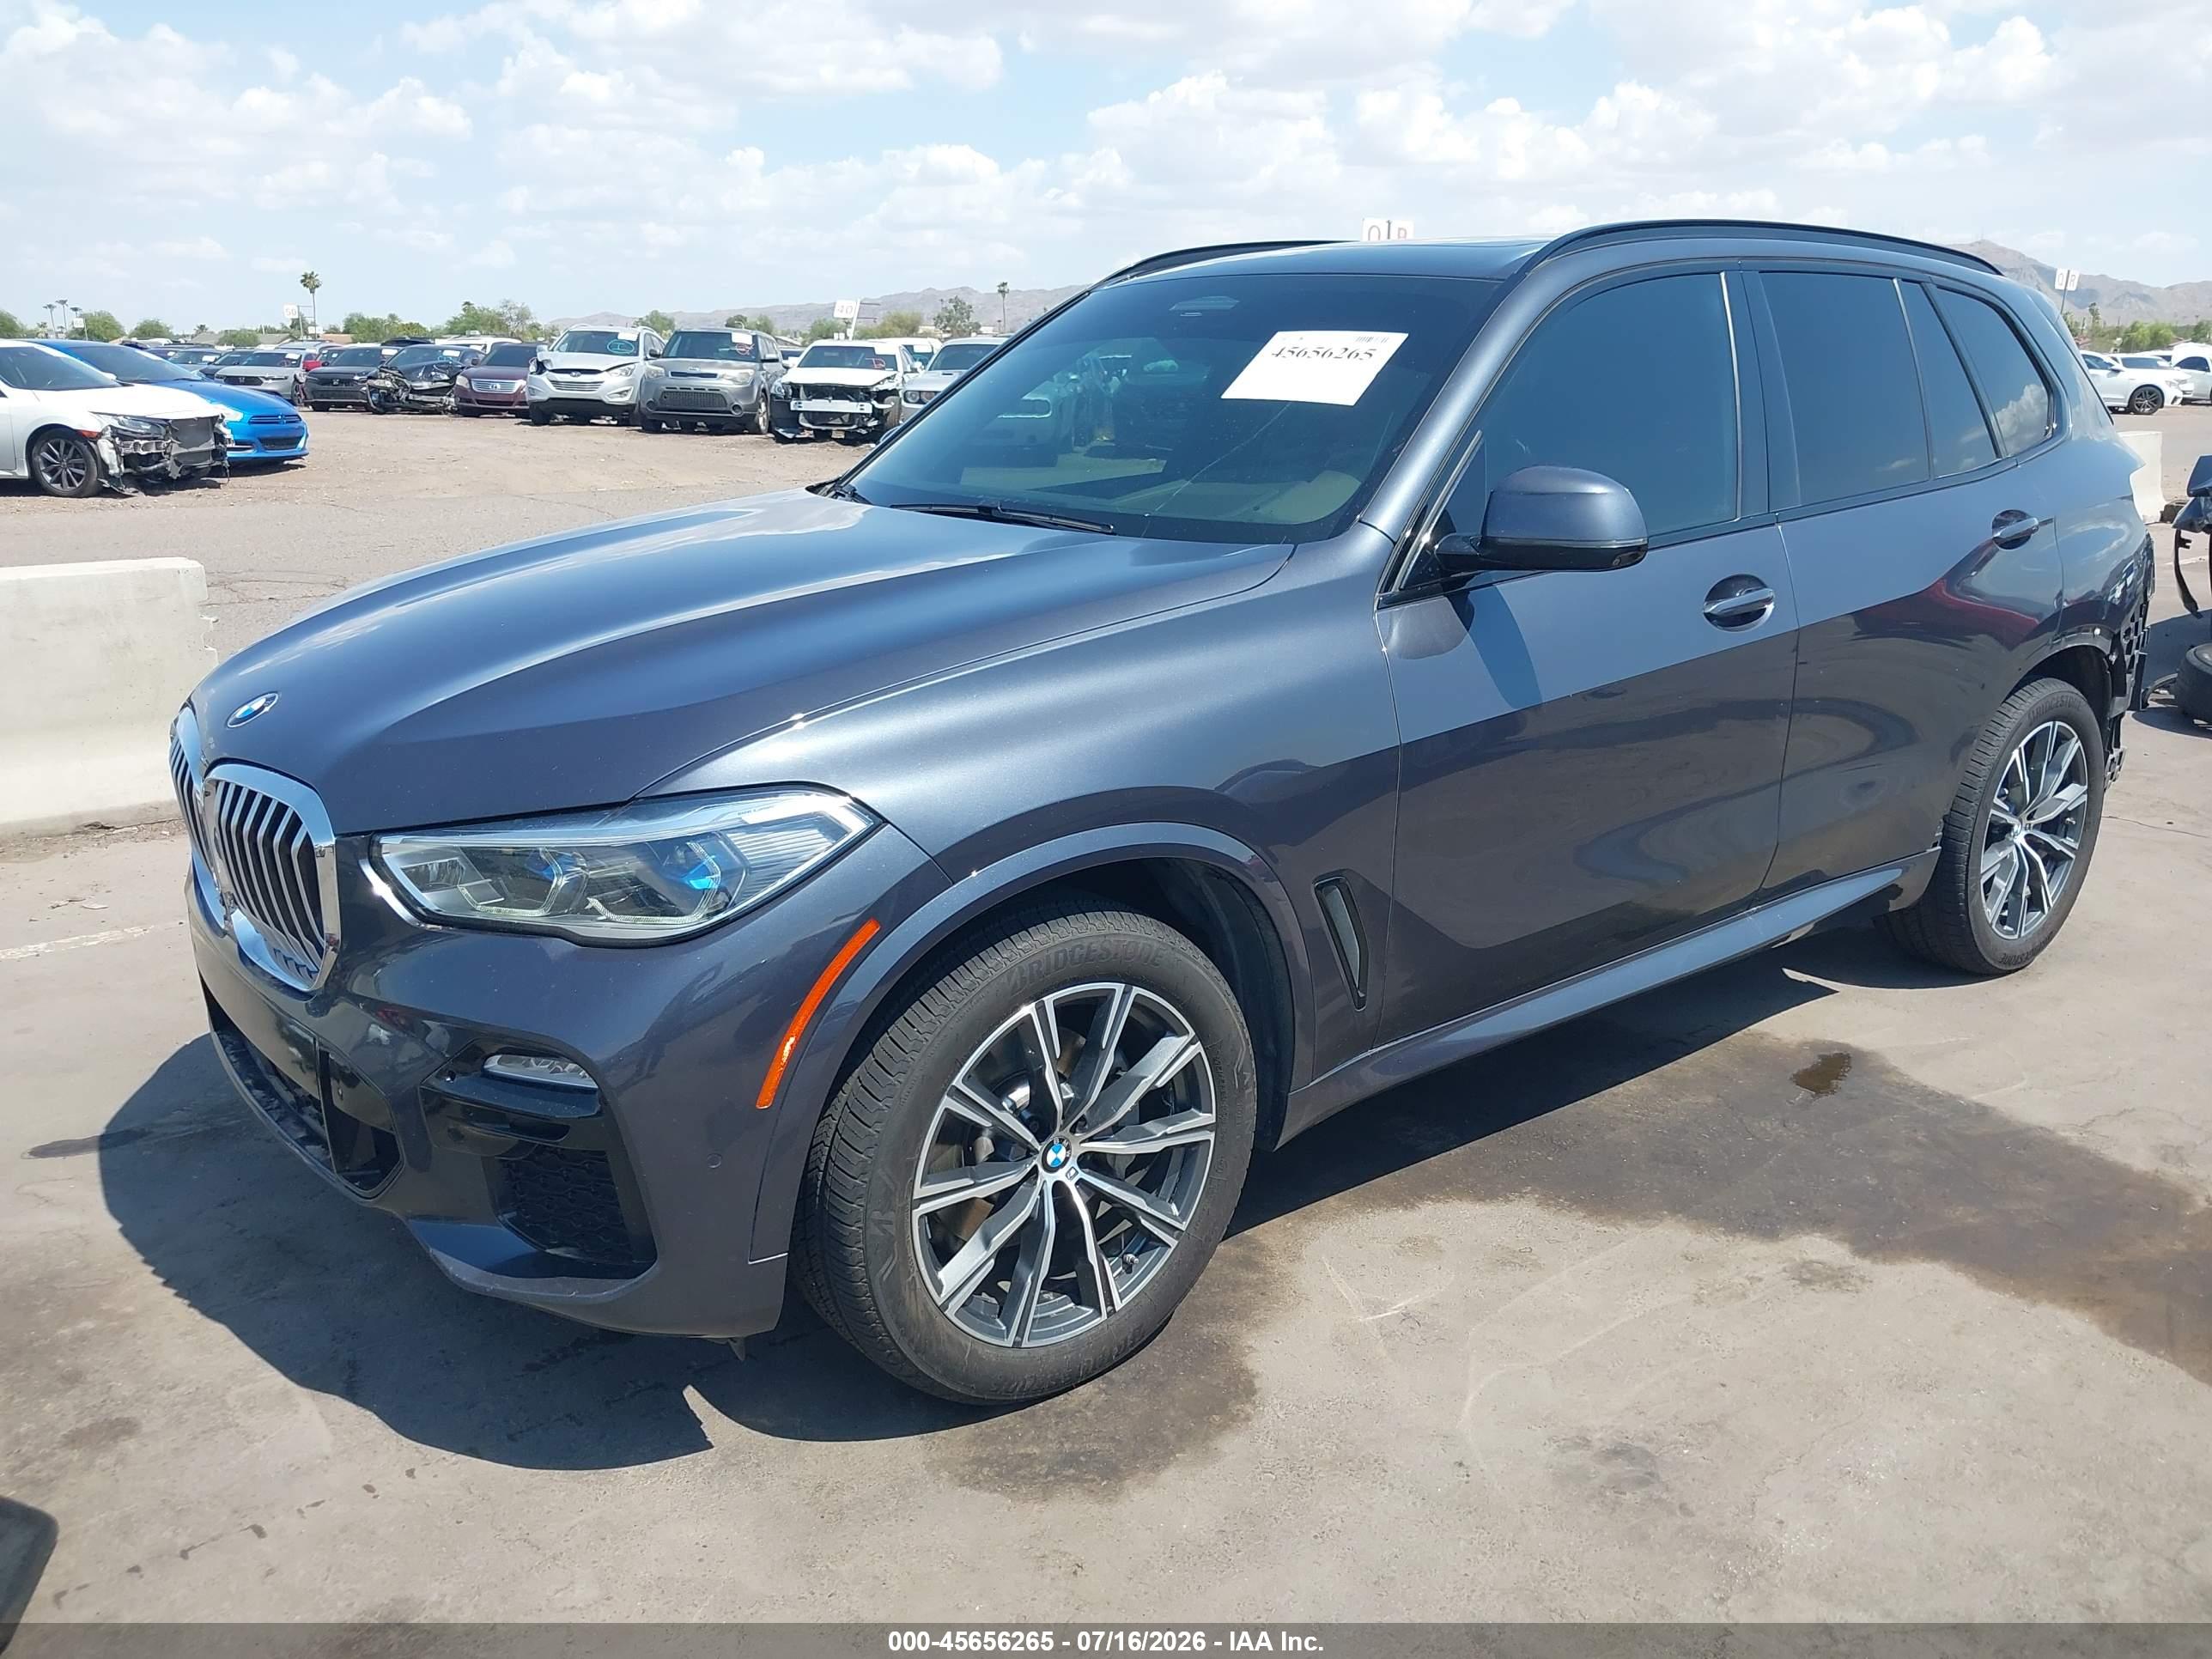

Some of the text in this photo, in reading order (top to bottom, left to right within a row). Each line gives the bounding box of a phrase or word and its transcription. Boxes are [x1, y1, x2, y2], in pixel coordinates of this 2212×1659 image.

[285, 307, 297, 316] 50
[1272, 345, 1378, 362] 45656265
[1005, 939, 1166, 998] BRIDGESTONE
[1053, 1138, 1072, 1158] BMW
